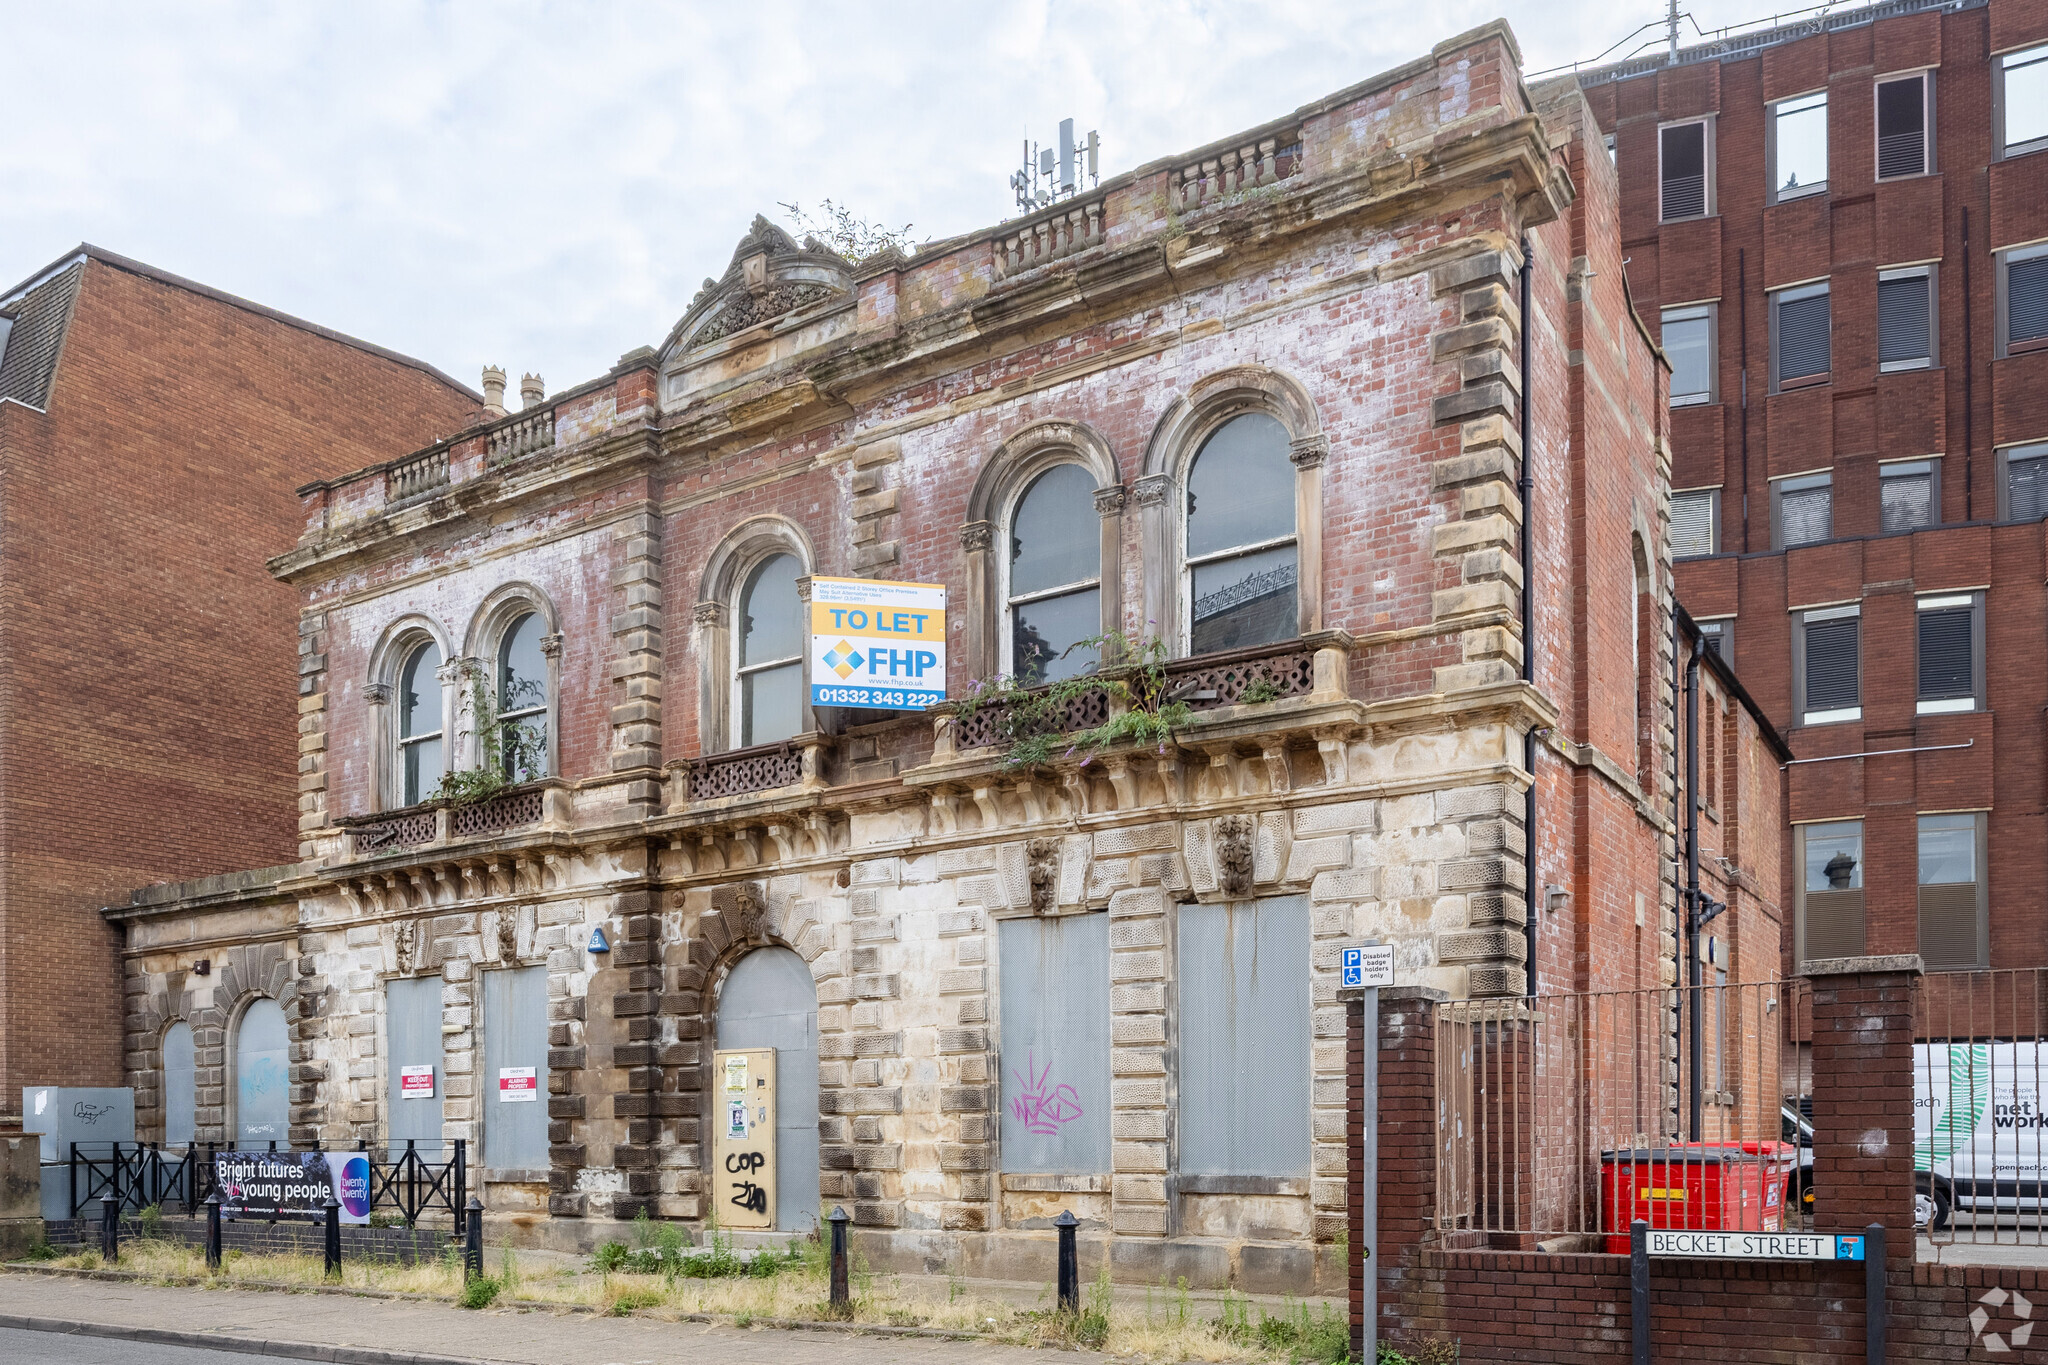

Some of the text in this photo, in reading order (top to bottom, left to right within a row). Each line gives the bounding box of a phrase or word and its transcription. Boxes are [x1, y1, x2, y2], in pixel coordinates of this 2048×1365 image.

[829, 608, 928, 633] TO LET
[869, 647, 937, 678] FHP
[869, 678, 923, 687] www.fhp.co.uk
[819, 688, 938, 707] 01332 343 222
[2009, 1087, 2033, 1095] pople
[1995, 1101, 2032, 1116] net
[219, 1161, 304, 1181] Bright futures
[241, 1184, 281, 1201] young
[284, 1180, 331, 1202] people
[341, 1176, 368, 1190] twenty
[341, 1188, 368, 1202] twenty
[1654, 1234, 1825, 1256] BECKET STREET
